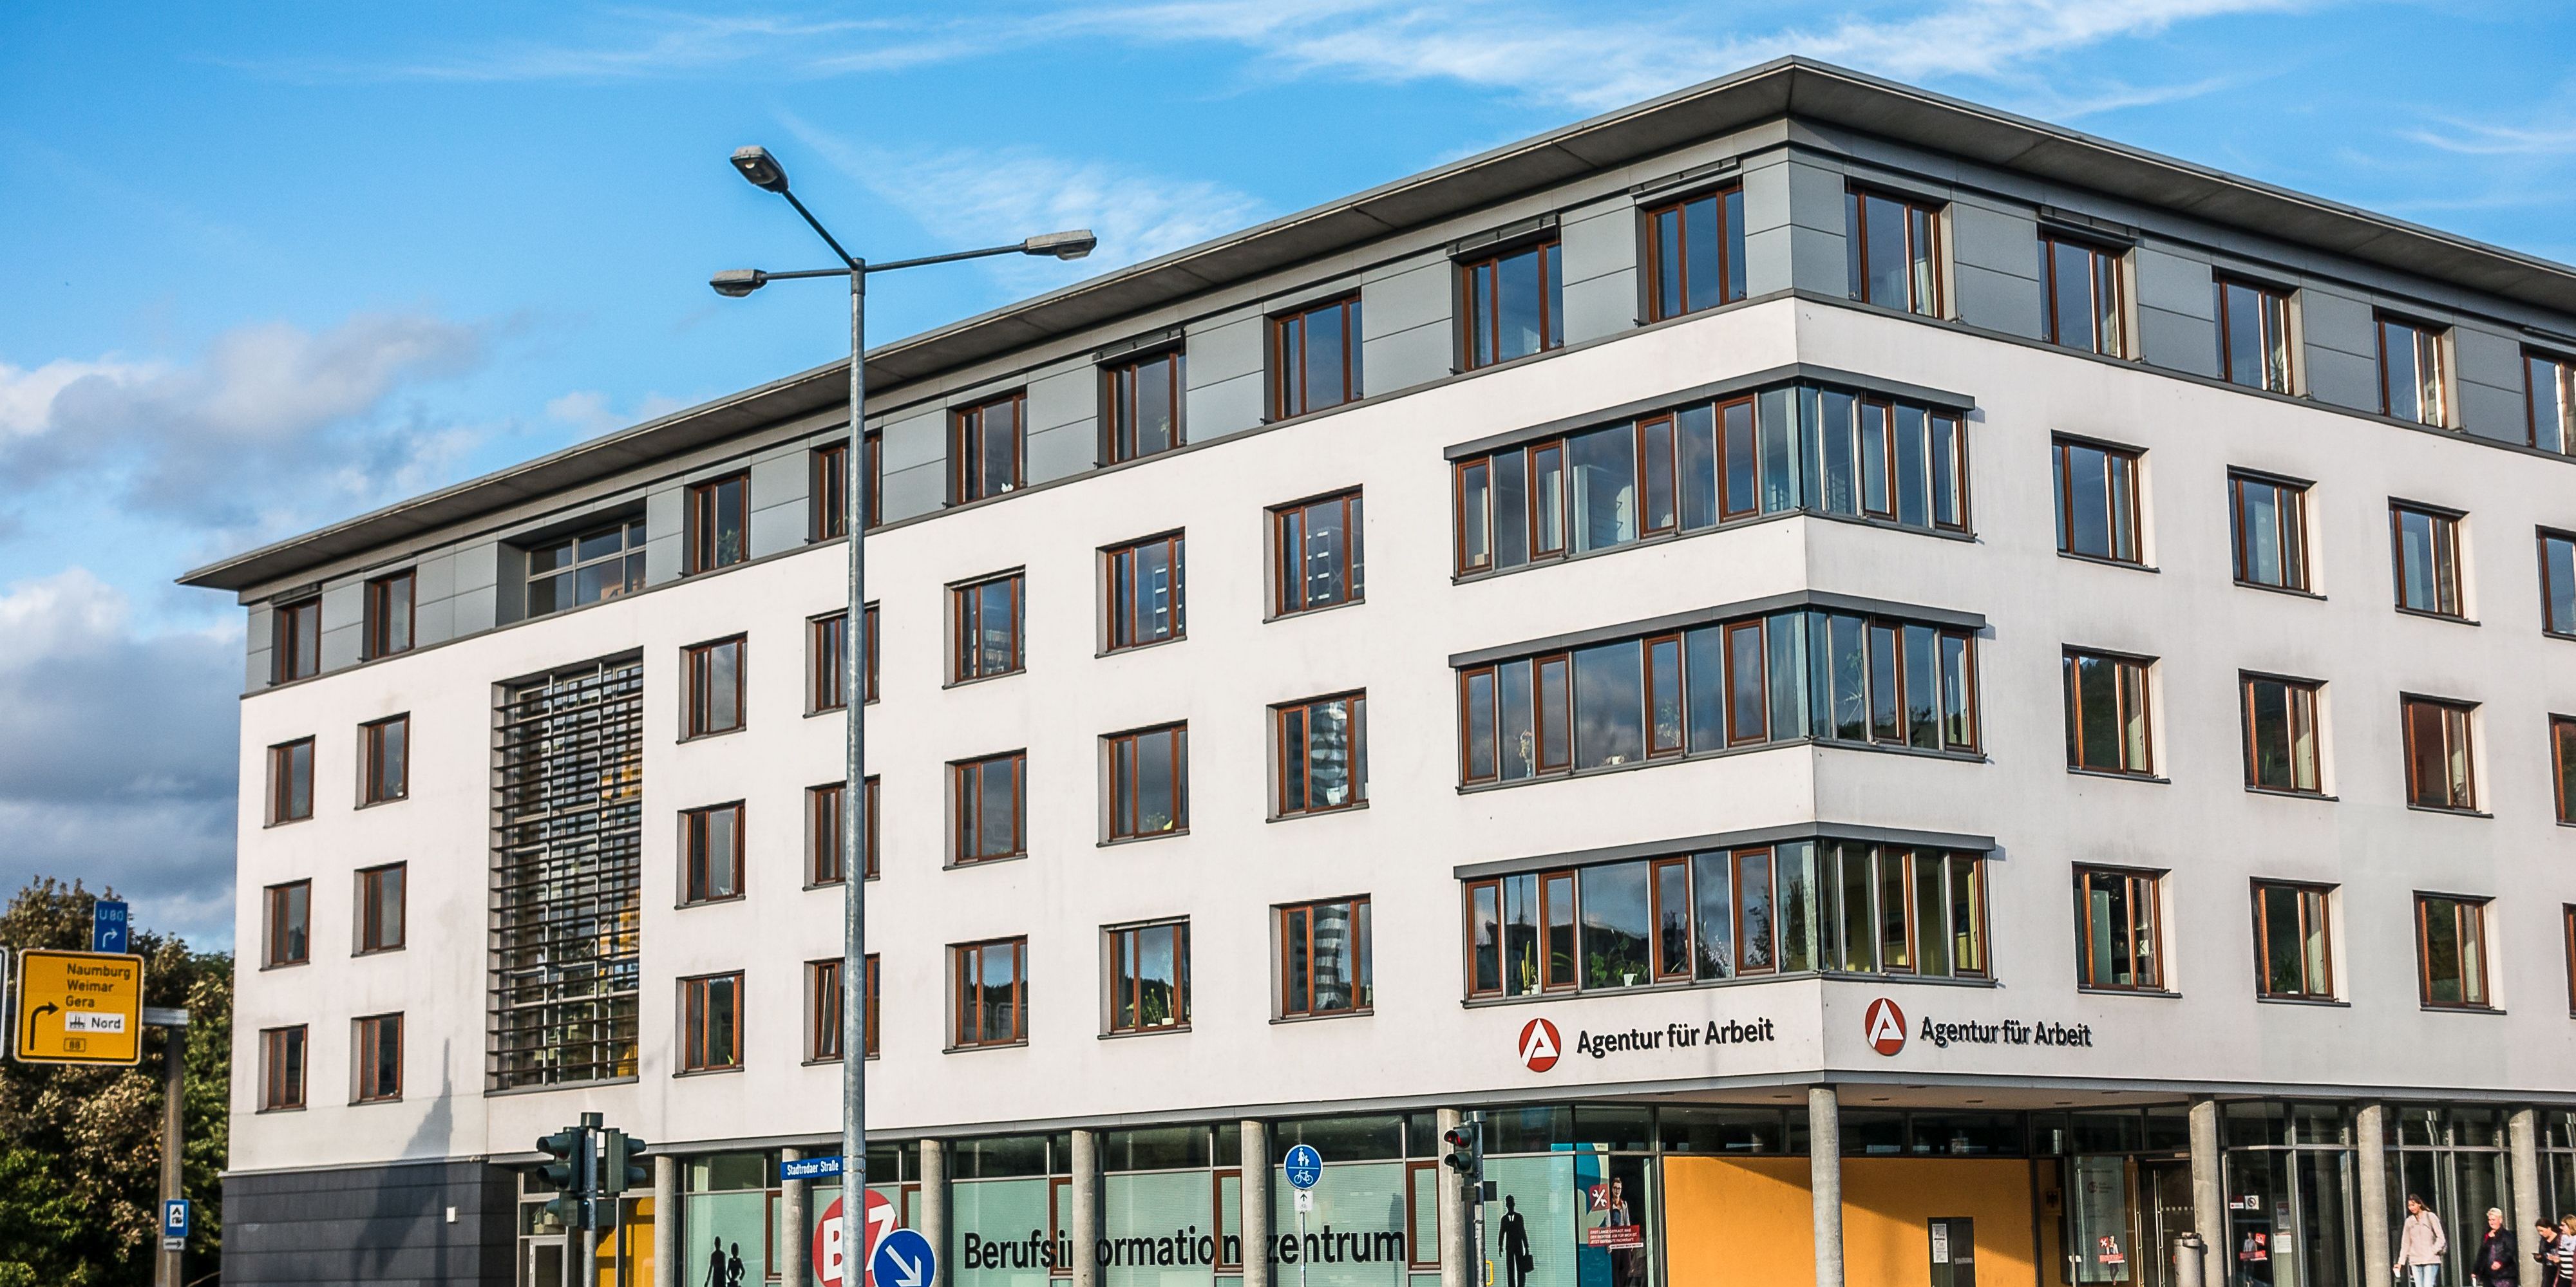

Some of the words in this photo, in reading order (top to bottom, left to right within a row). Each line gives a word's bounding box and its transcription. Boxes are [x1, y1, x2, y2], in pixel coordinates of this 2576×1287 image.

[99, 908, 108, 921] U
[109, 909, 124, 922] 80
[67, 963, 131, 981] Naumburg
[67, 979, 114, 992] Weimar
[66, 995, 95, 1008] Gera
[91, 1017, 121, 1029] Nord
[1920, 1016, 1998, 1047] Agentur
[2001, 1019, 2031, 1044] für
[2034, 1021, 2092, 1047] Arbeit
[1577, 1030, 1663, 1059] Agentur
[1667, 1023, 1700, 1047] für
[1705, 1017, 1775, 1046] Arbeit
[787, 1162, 819, 1176] Stadtrodaer
[820, 1160, 839, 1172] Straße
[824, 1203, 896, 1282] BZ
[964, 1225, 1405, 1269] Berufsiormationzentrum
